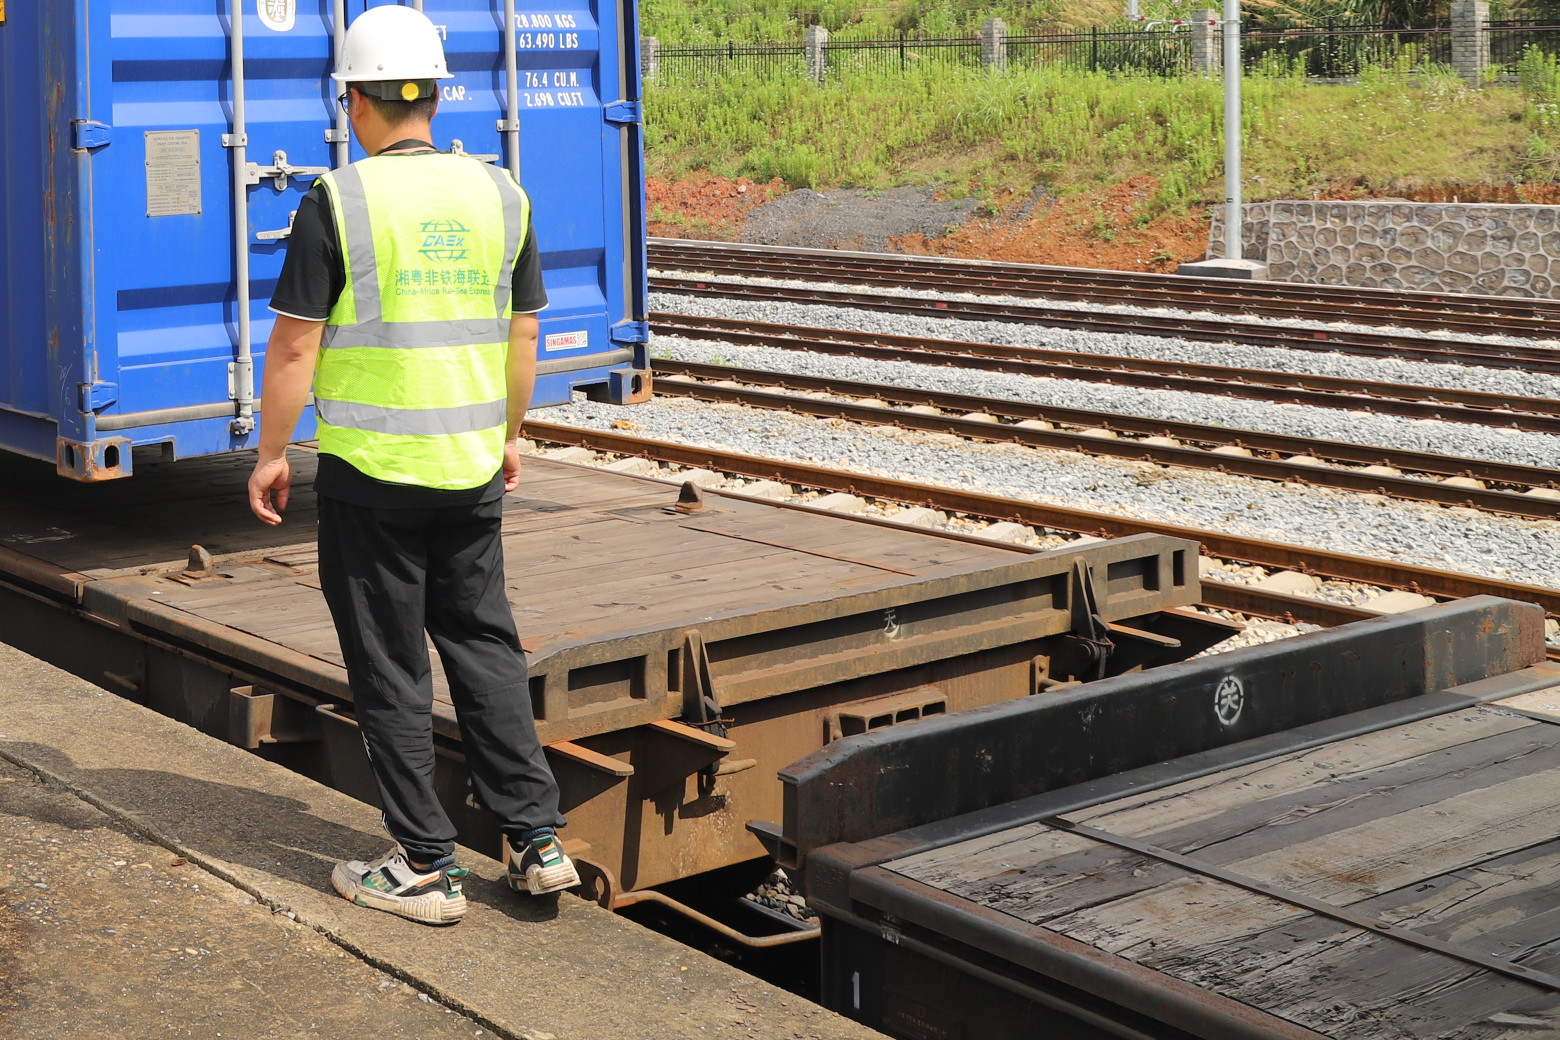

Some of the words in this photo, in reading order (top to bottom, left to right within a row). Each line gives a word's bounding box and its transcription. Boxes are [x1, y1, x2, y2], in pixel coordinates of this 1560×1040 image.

[514, 14, 553, 28] 28.800
[554, 14, 577, 28] KGS
[519, 33, 555, 49] 63.490
[559, 33, 579, 49] LBS
[525, 72, 548, 88] 76.4
[554, 72, 580, 87] CU.M.
[524, 92, 555, 107] 2.698
[557, 92, 585, 107] CU.FT
[395, 287, 440, 296] China-Africa
[546, 336, 577, 348] SINGAMAS
[851, 971, 861, 1009] 1
